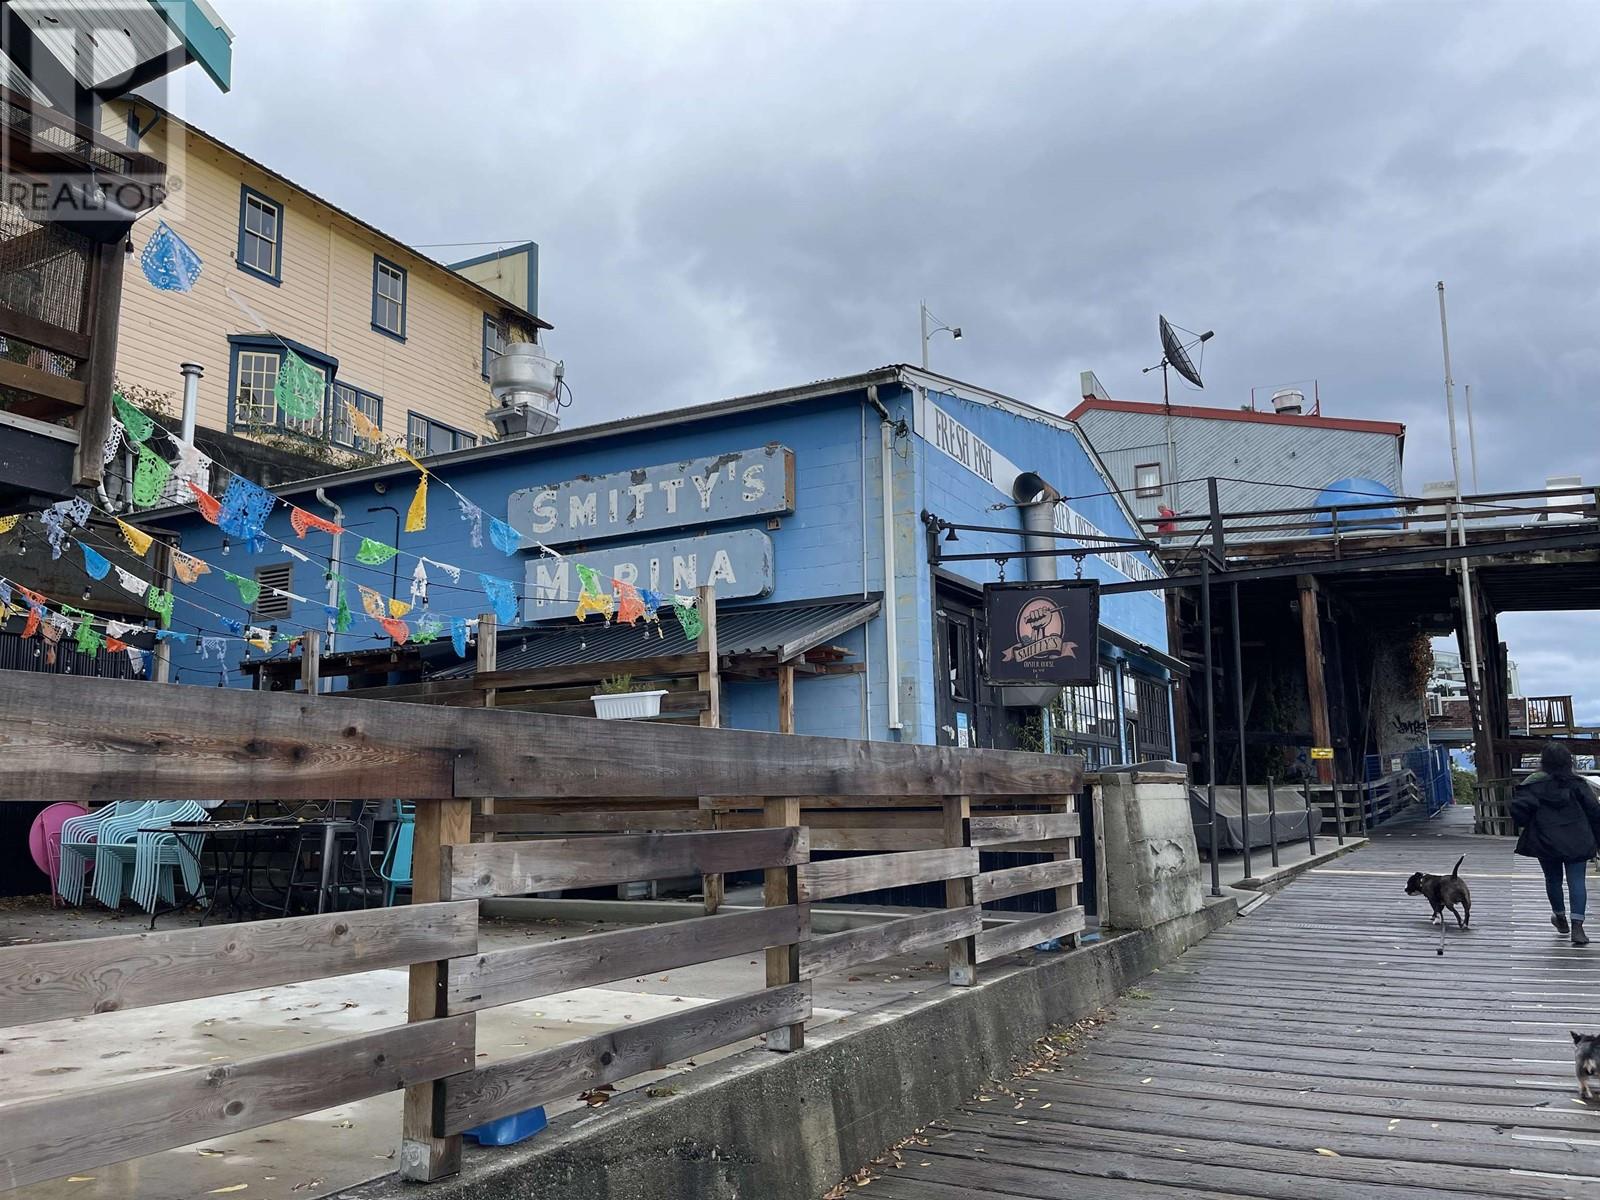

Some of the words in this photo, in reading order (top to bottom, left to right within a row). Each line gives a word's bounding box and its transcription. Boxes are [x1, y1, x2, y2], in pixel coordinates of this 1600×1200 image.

[935, 407, 971, 468] FRESH
[972, 436, 994, 484] FISH
[532, 461, 767, 533] SMITTY'S
[1018, 636, 1059, 660] SMITTY'S
